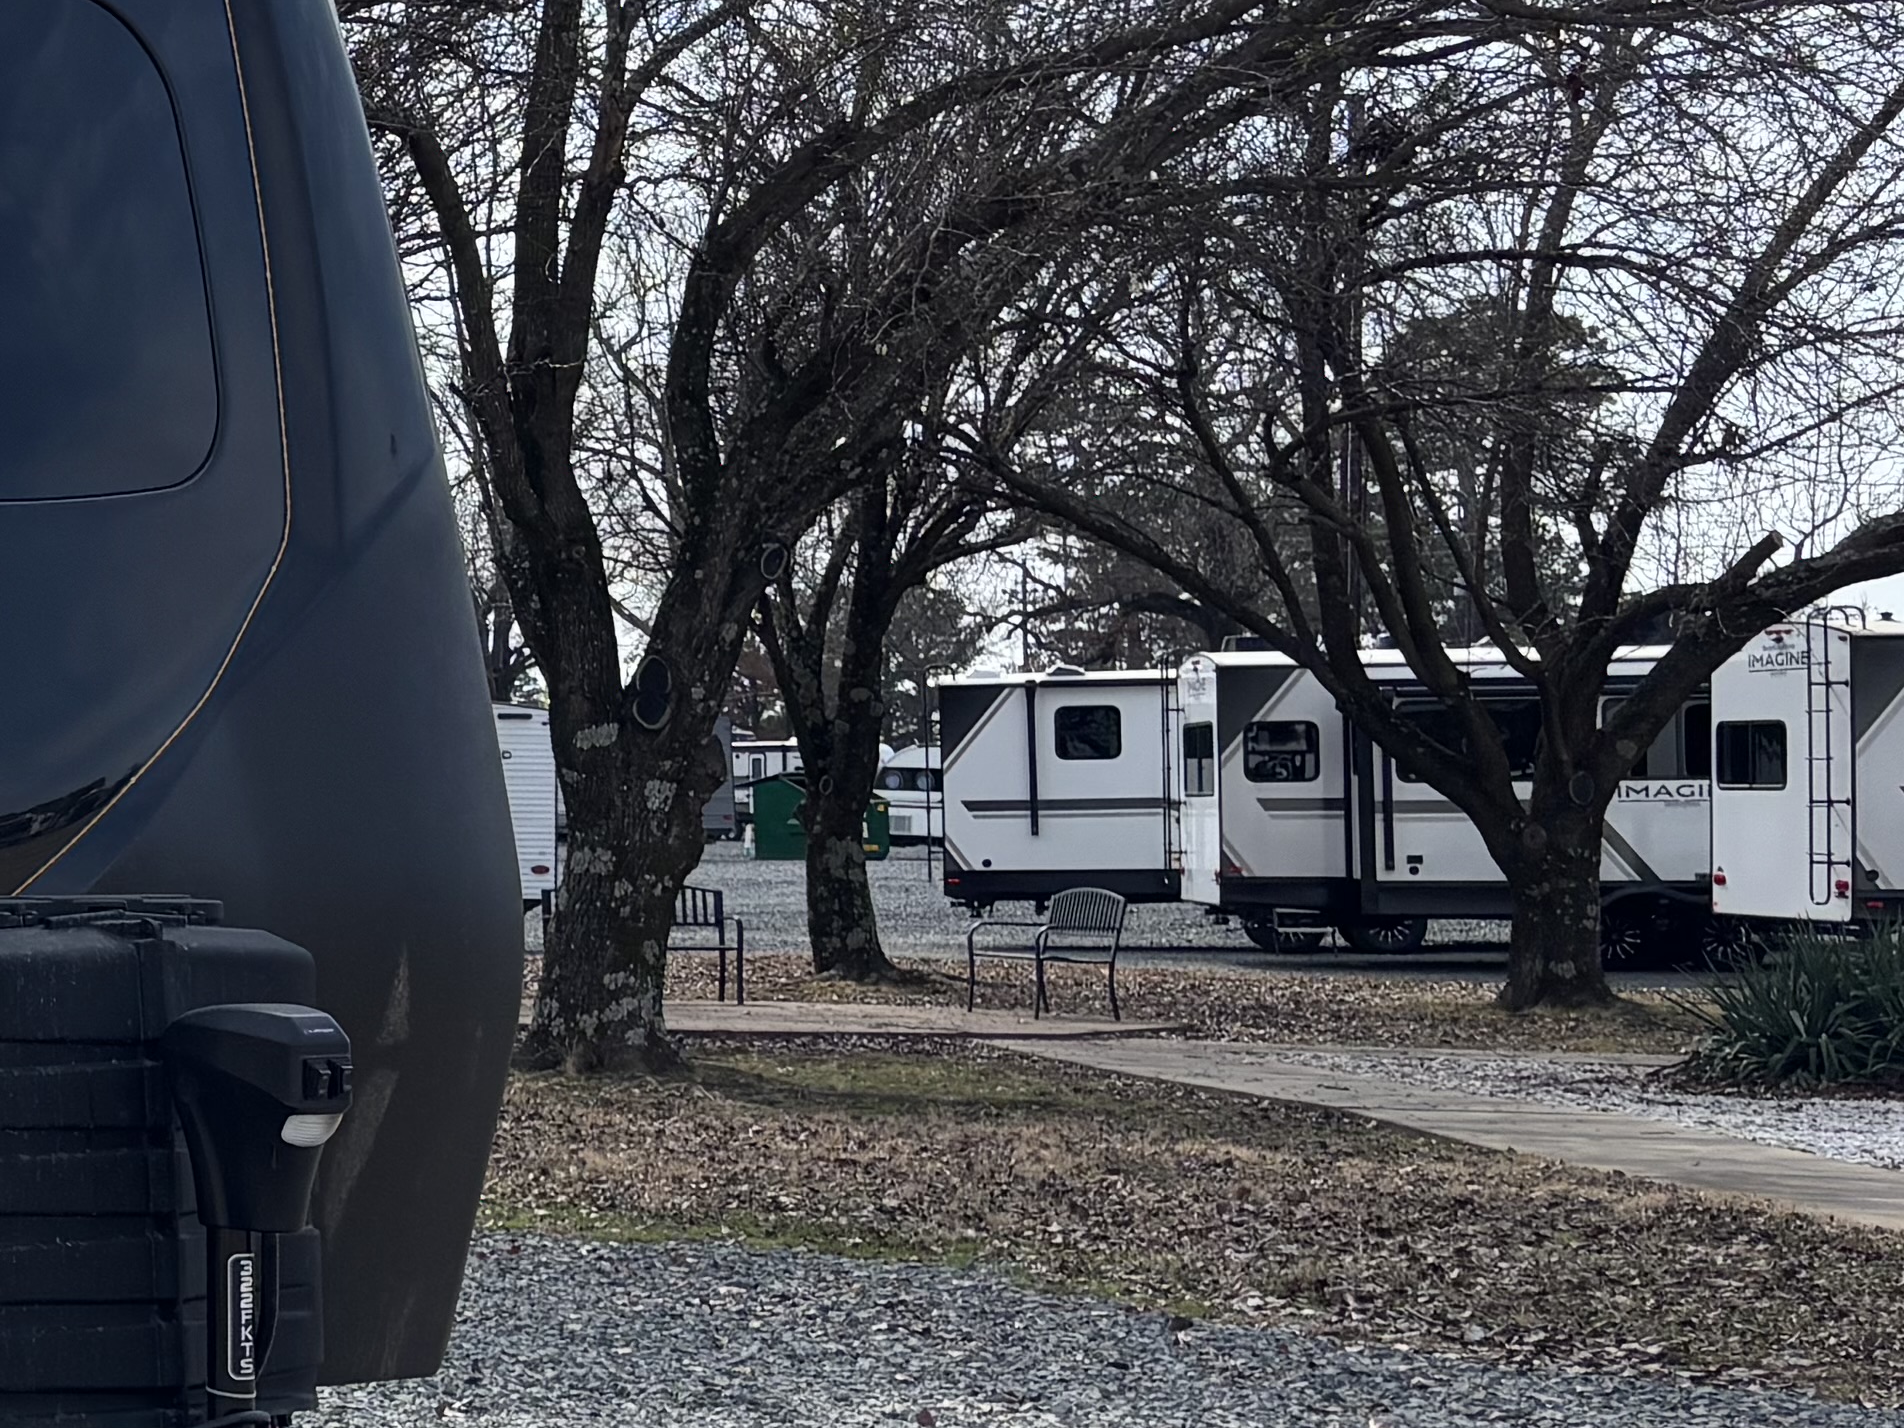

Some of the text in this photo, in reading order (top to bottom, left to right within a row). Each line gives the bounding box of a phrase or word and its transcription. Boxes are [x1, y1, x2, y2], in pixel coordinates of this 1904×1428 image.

[1748, 650, 1810, 669] IMAGINE
[1617, 783, 1712, 799] IMAGI
[239, 1259, 255, 1374] 322FKTS
